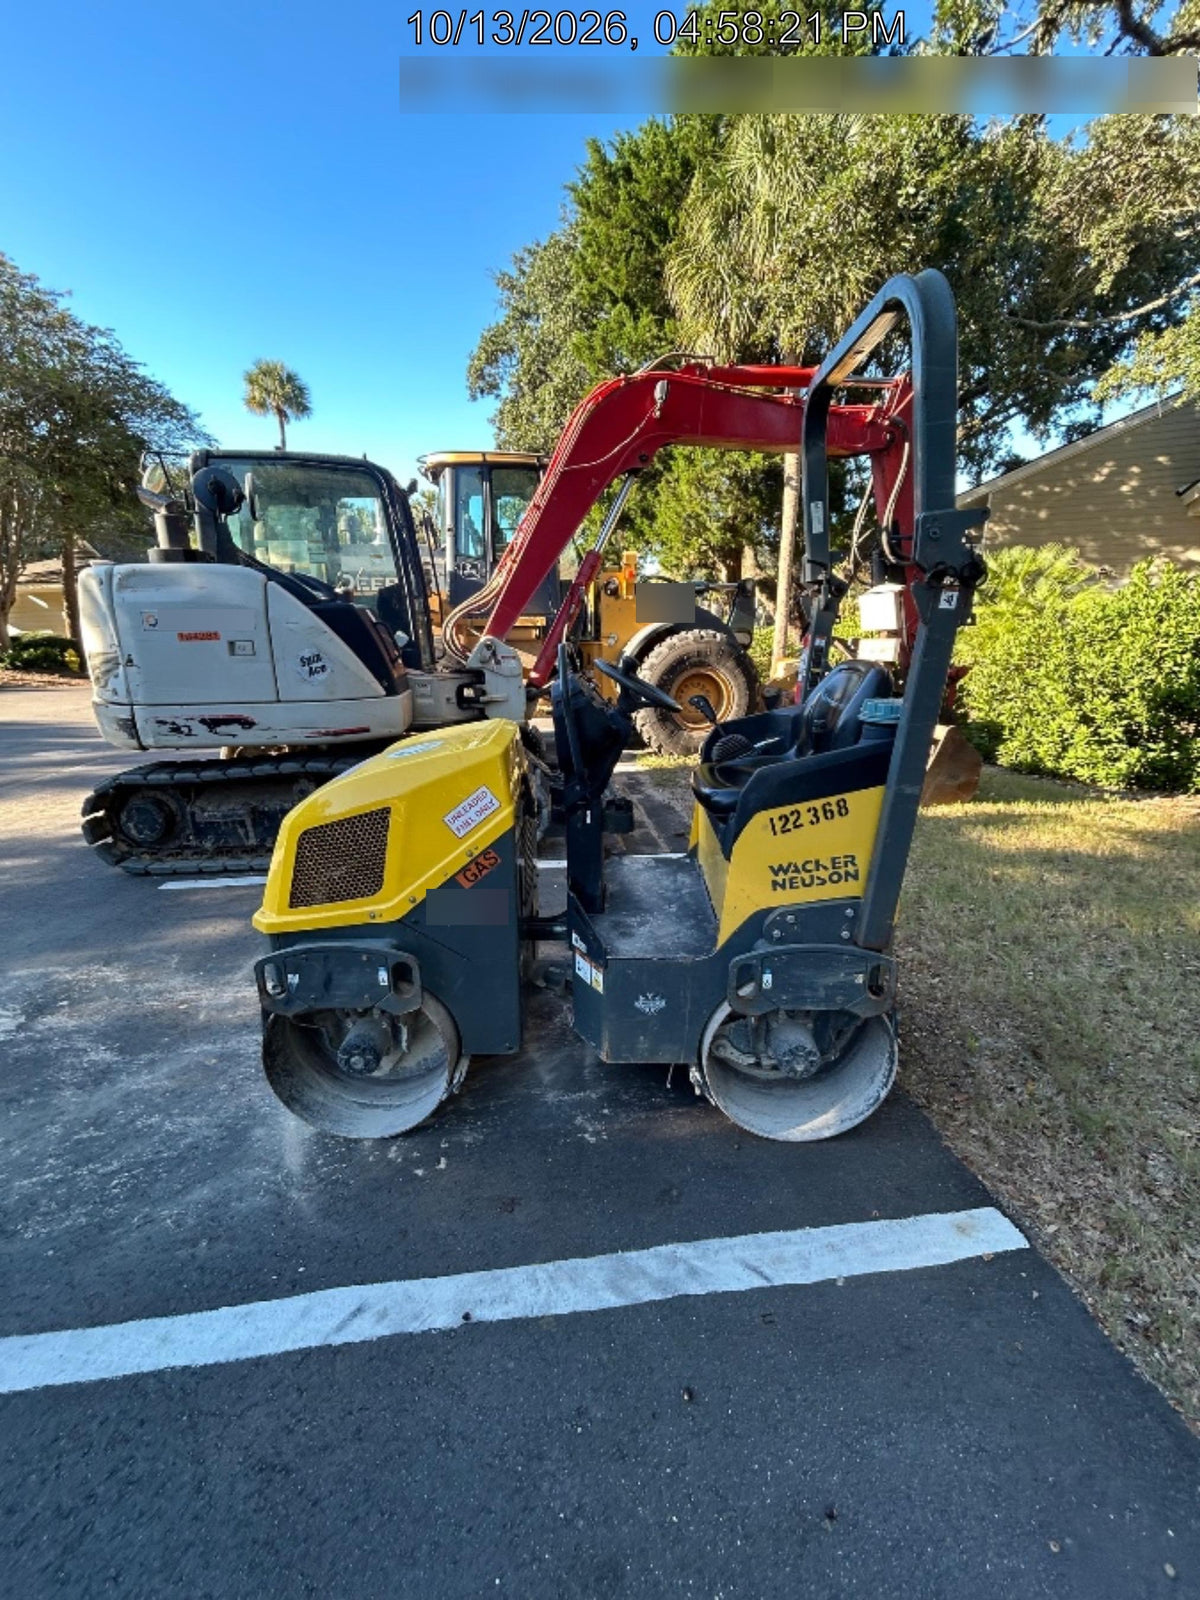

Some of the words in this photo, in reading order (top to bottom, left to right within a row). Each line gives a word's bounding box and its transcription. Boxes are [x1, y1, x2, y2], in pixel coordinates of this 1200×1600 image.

[338, 573, 399, 591] DEER
[447, 790, 488, 825] UNLEADED
[474, 798, 496, 817] ONLY
[463, 850, 499, 883] GAS
[768, 854, 858, 877] WACKER
[771, 869, 859, 891] NEUSON
